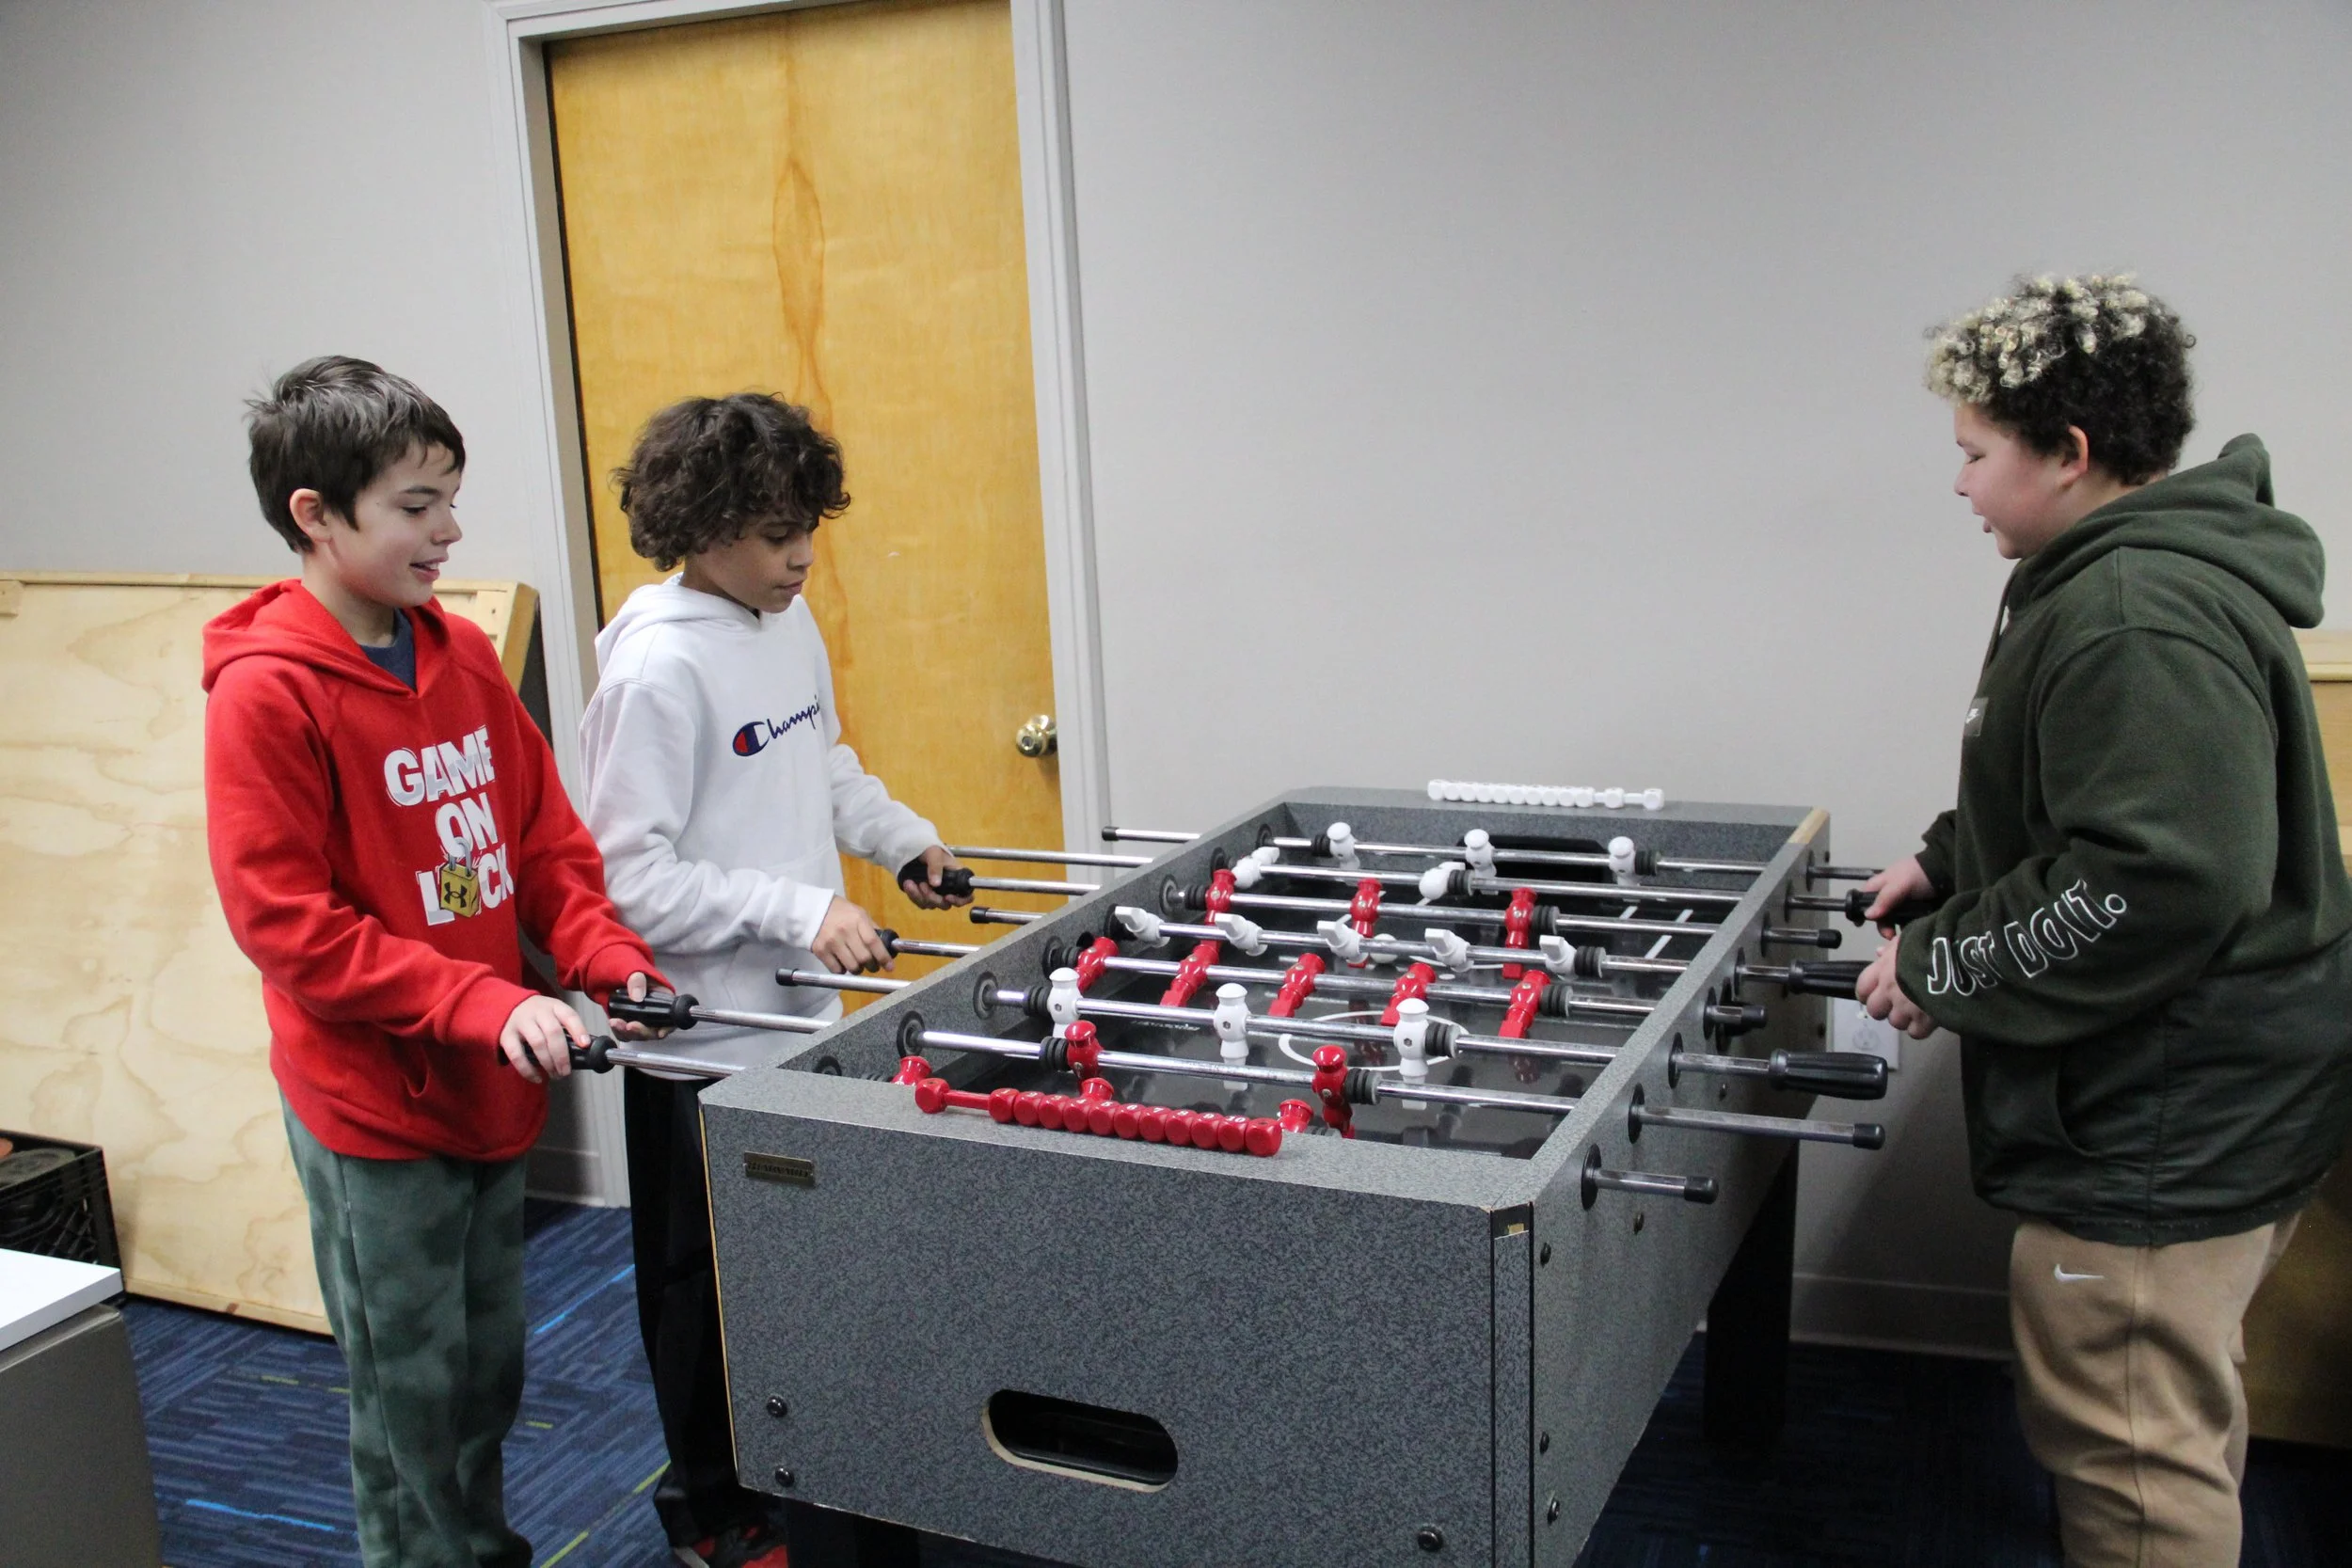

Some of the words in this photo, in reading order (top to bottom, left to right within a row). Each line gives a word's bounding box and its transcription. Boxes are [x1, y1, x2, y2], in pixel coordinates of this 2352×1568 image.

[383, 725, 497, 807] GAME
[435, 792, 499, 858] ON
[415, 843, 515, 927] LCK
[1927, 929, 2004, 997] JUST
